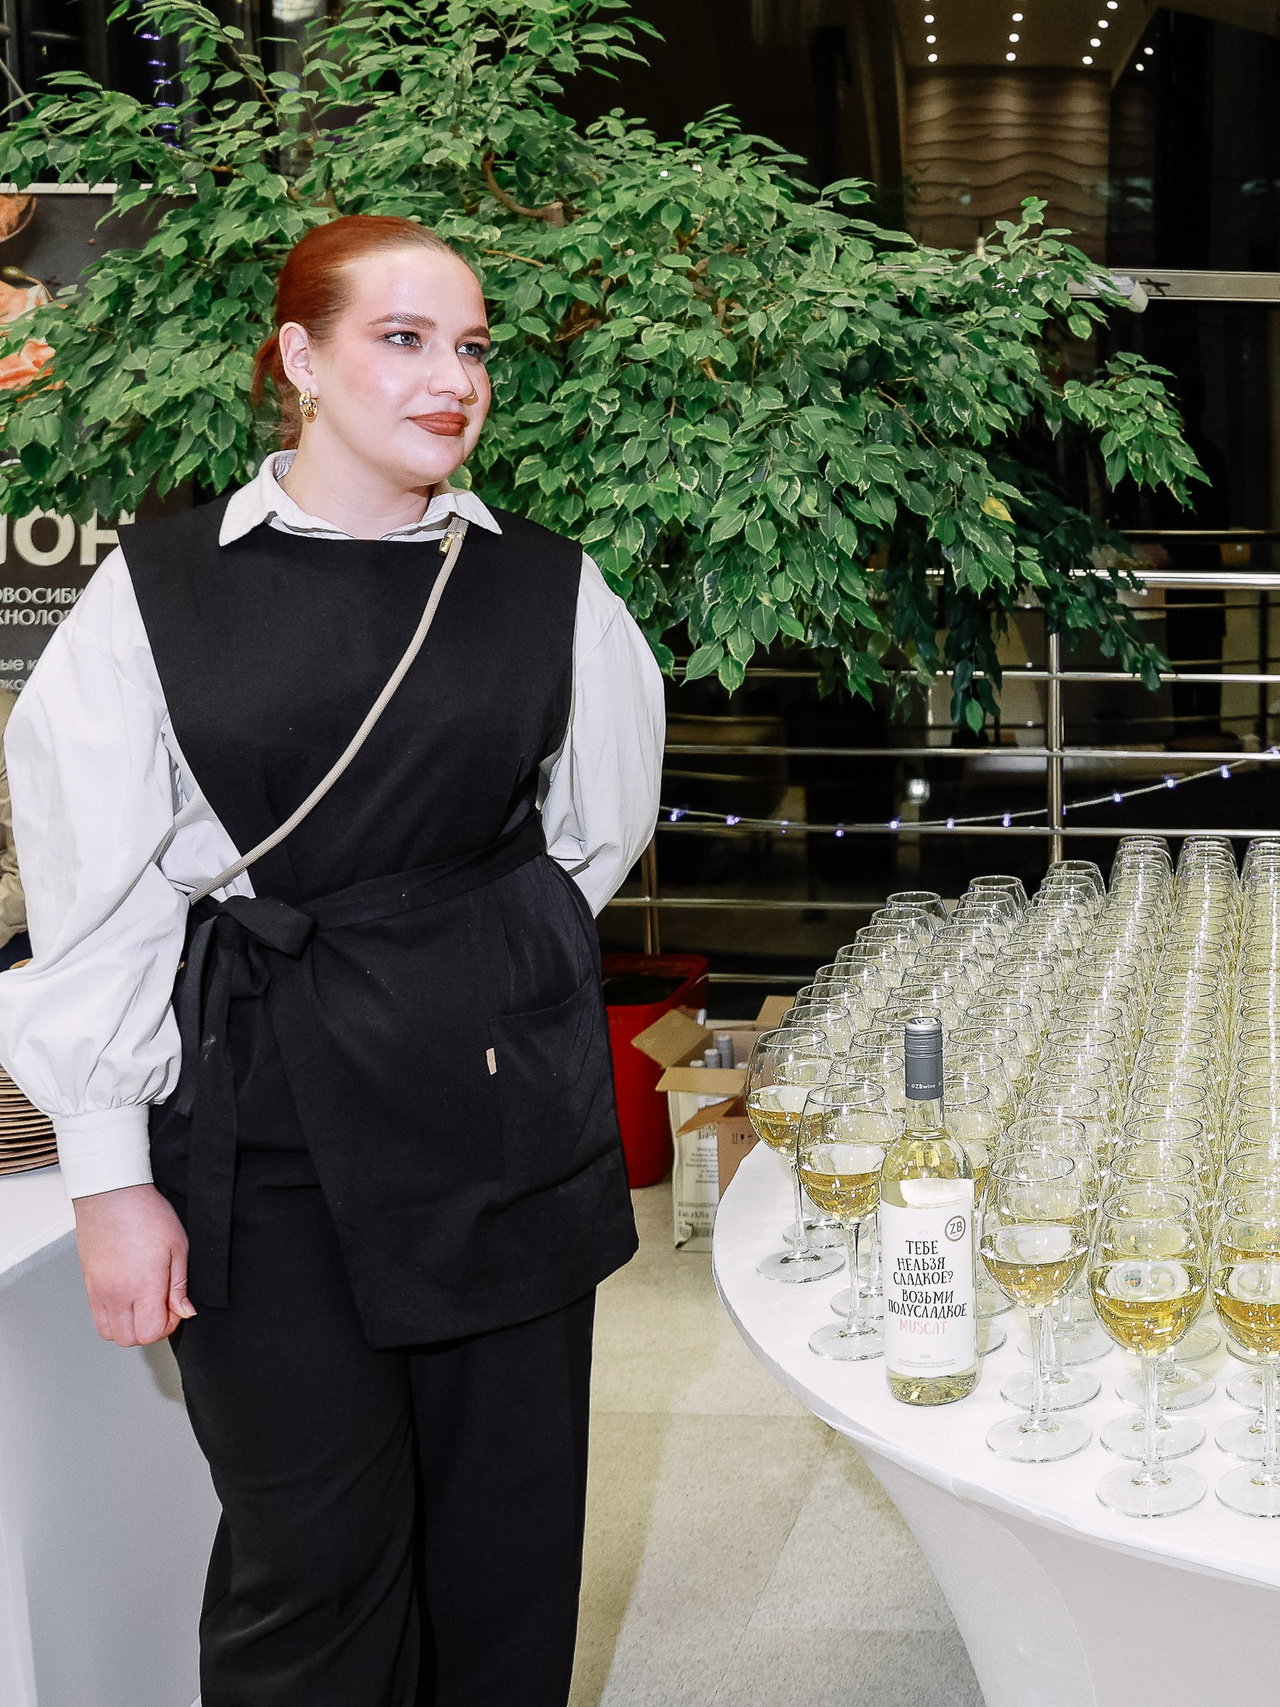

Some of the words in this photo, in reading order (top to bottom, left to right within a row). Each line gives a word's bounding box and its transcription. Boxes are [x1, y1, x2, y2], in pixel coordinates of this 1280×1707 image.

[0, 505, 136, 567] ОН
[949, 1221, 963, 1235] ZB
[905, 1240, 939, 1255] ТЕБЕ
[897, 1257, 946, 1271] НЕЛЬЗЯ
[892, 1270, 954, 1287] СЛАДКОЕ?
[902, 1289, 954, 1305] ВОЗЬМИ
[888, 1299, 968, 1320] ПОЛУСЛАДКОЕ
[899, 1320, 948, 1335] MUSCAT
